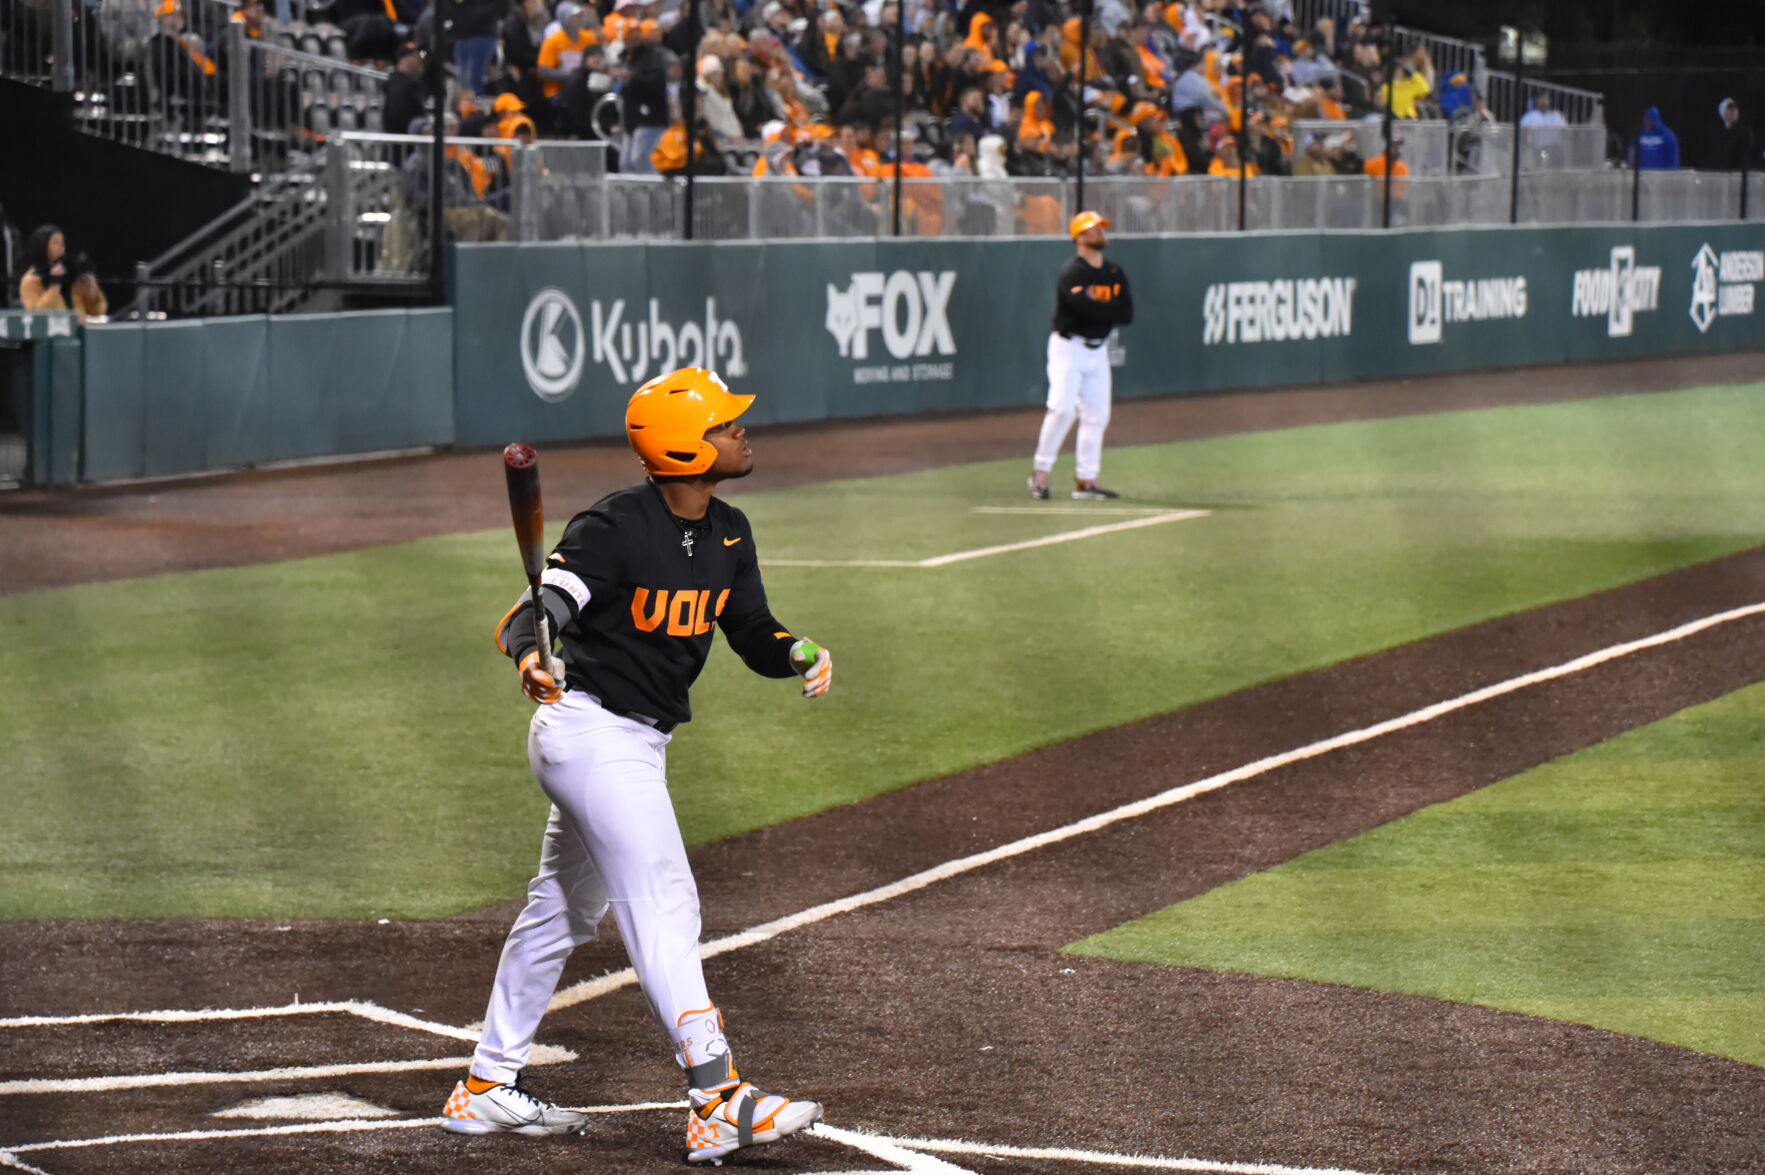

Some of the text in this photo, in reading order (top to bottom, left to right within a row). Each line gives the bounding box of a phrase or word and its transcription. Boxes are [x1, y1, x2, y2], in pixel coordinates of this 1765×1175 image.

[851, 269, 957, 359] FOX
[1226, 277, 1353, 344] FERGUSON
[1443, 276, 1528, 323] TRAINING
[1572, 269, 1610, 317] FOOD
